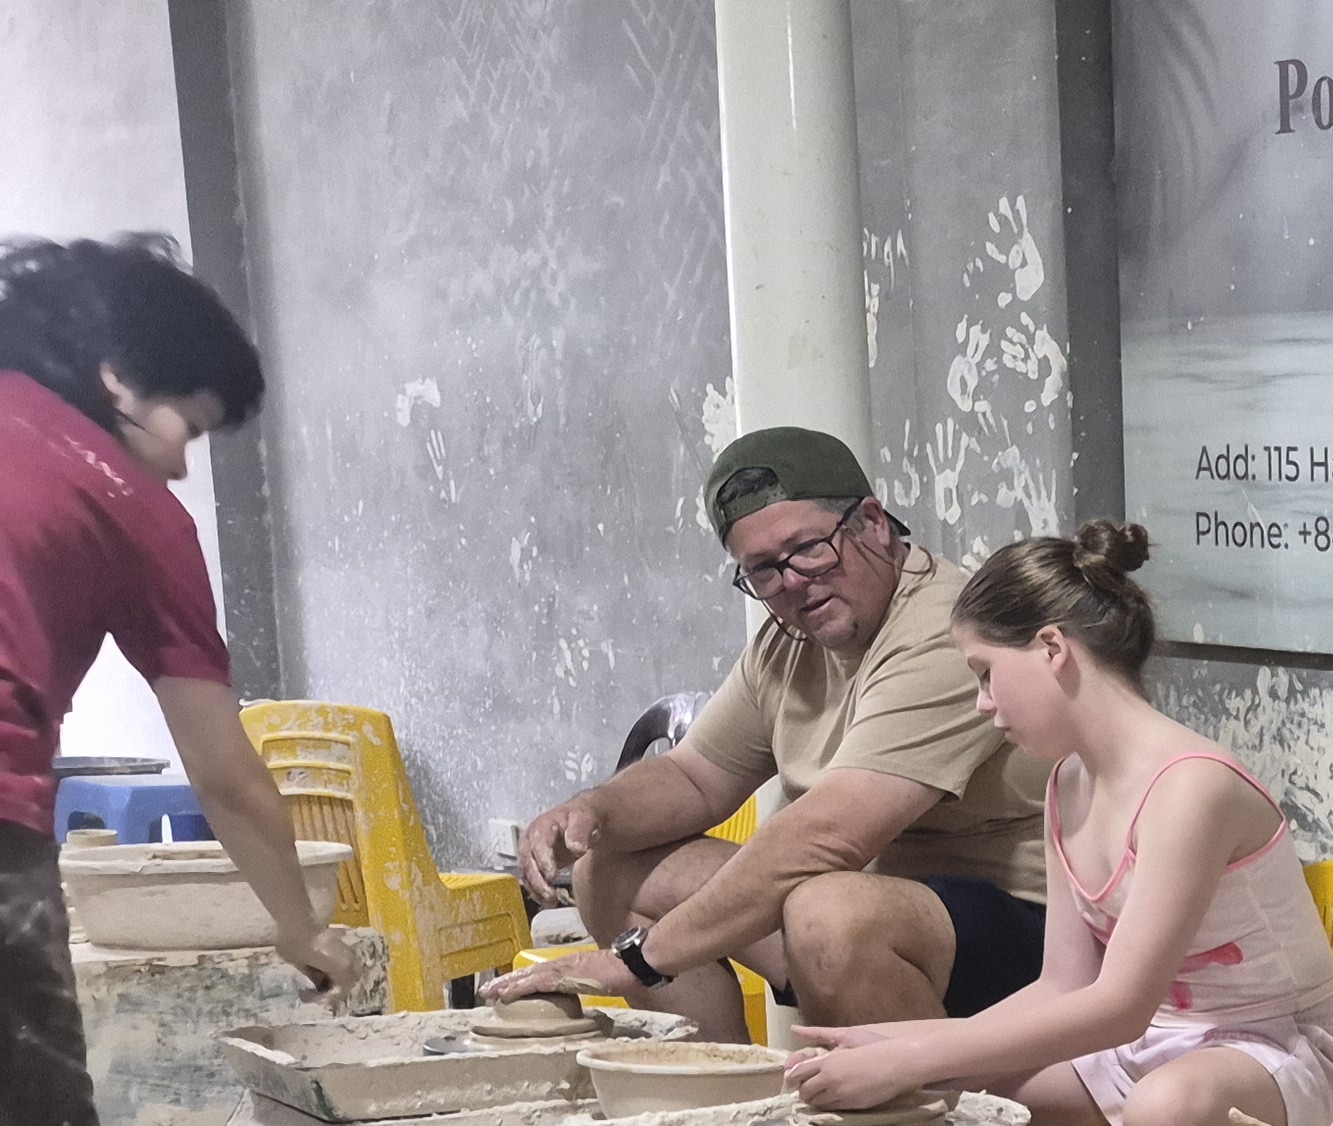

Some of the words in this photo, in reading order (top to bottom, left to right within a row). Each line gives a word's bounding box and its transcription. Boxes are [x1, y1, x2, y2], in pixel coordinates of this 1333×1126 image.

[1195, 443, 1256, 482] Add:
[1263, 446, 1300, 482] 115
[1195, 510, 1290, 550] Phone:
